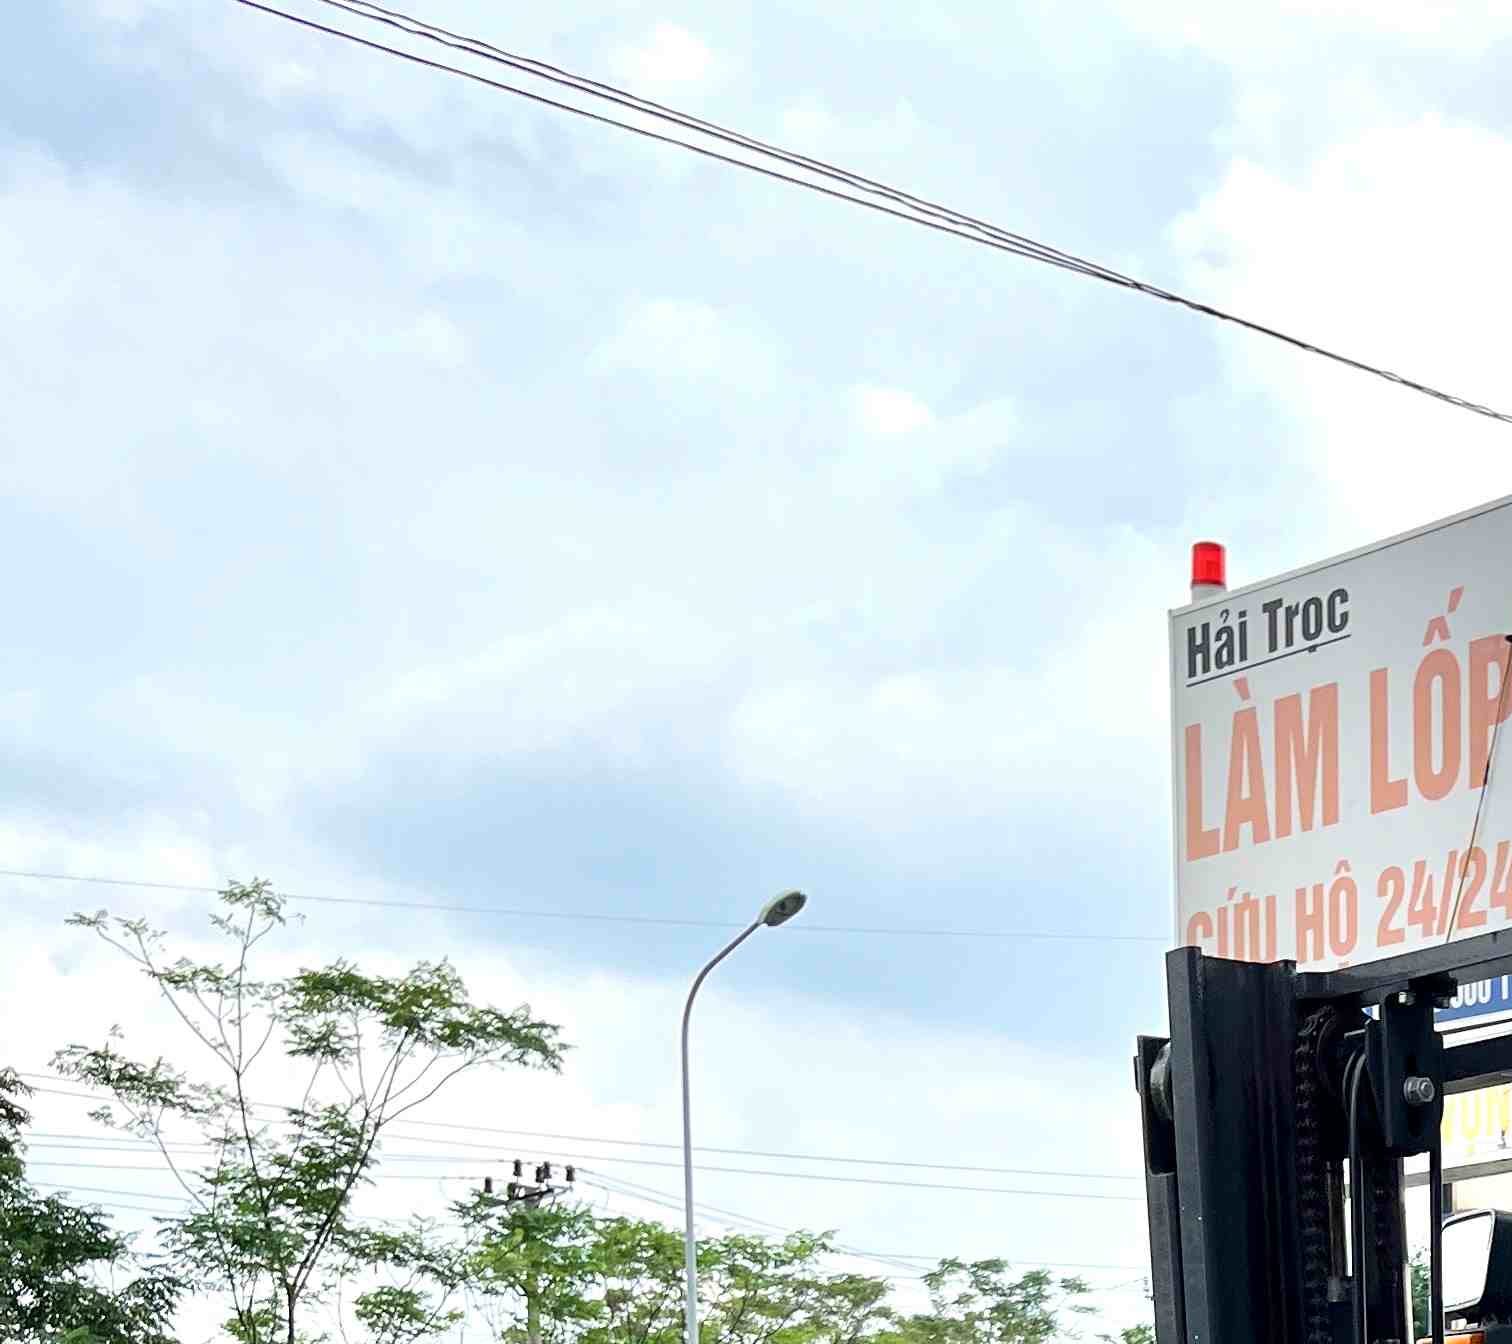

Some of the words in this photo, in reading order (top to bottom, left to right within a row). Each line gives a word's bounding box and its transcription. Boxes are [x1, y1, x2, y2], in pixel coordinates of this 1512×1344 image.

[1187, 608, 1248, 678] Hải
[1262, 587, 1350, 652] Trọc
[1185, 677, 1340, 862] LÀM
